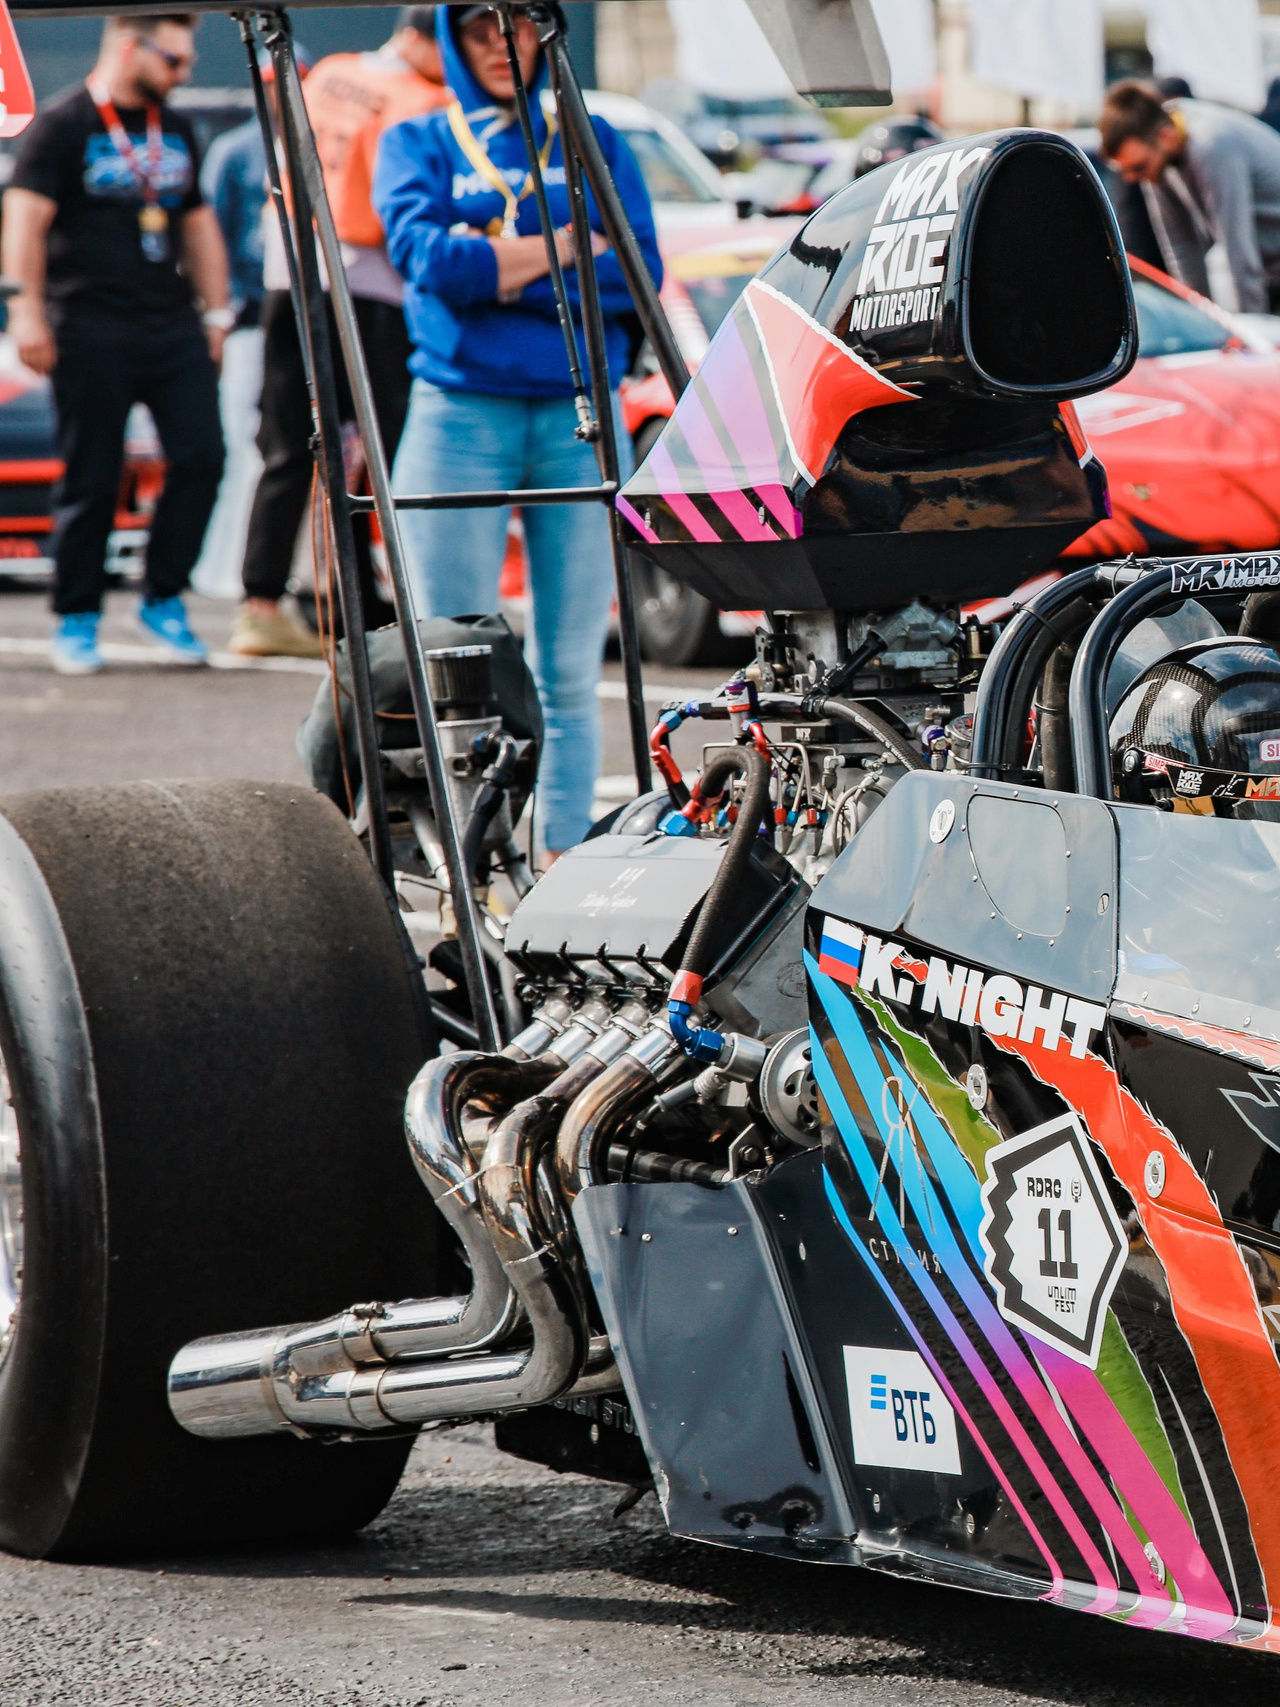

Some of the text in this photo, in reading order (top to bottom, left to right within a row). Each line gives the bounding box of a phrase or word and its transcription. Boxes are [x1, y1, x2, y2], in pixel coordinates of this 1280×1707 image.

[873, 147, 991, 225] MAX
[849, 286, 940, 331] MOTORSPORT
[1178, 770, 1204, 782] MAX
[1027, 1177, 1061, 1198] RDRC
[1038, 1208, 1078, 1279] 11
[1055, 1299, 1075, 1314] FEST
[891, 1389, 936, 1444] ВТБ
